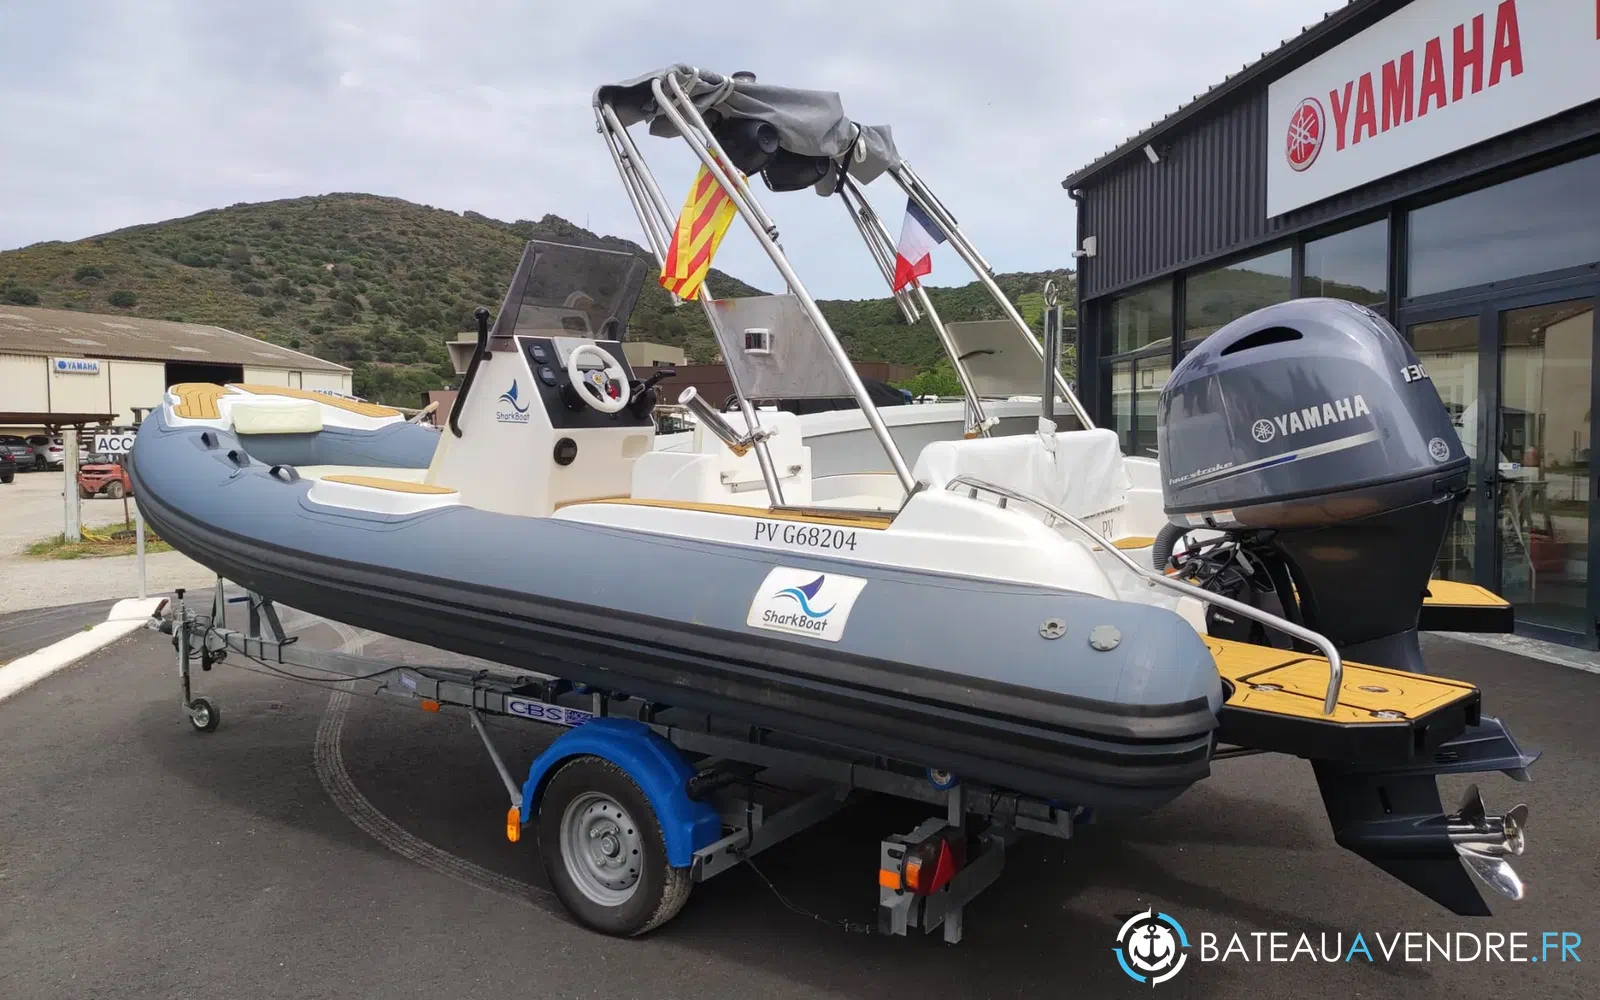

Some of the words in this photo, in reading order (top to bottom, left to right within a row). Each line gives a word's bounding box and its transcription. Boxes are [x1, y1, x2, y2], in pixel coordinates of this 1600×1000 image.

[1329, 0, 1524, 152] YAMAHA
[67, 361, 98, 371] YAMAHA
[496, 411, 530, 421] SharkBoat
[1273, 394, 1371, 437] YAMAHA
[754, 522, 779, 542] PV
[783, 525, 857, 551] G68204
[1102, 518, 1114, 539] PV
[762, 609, 828, 632] SharkBoat
[509, 701, 563, 721] CBS
